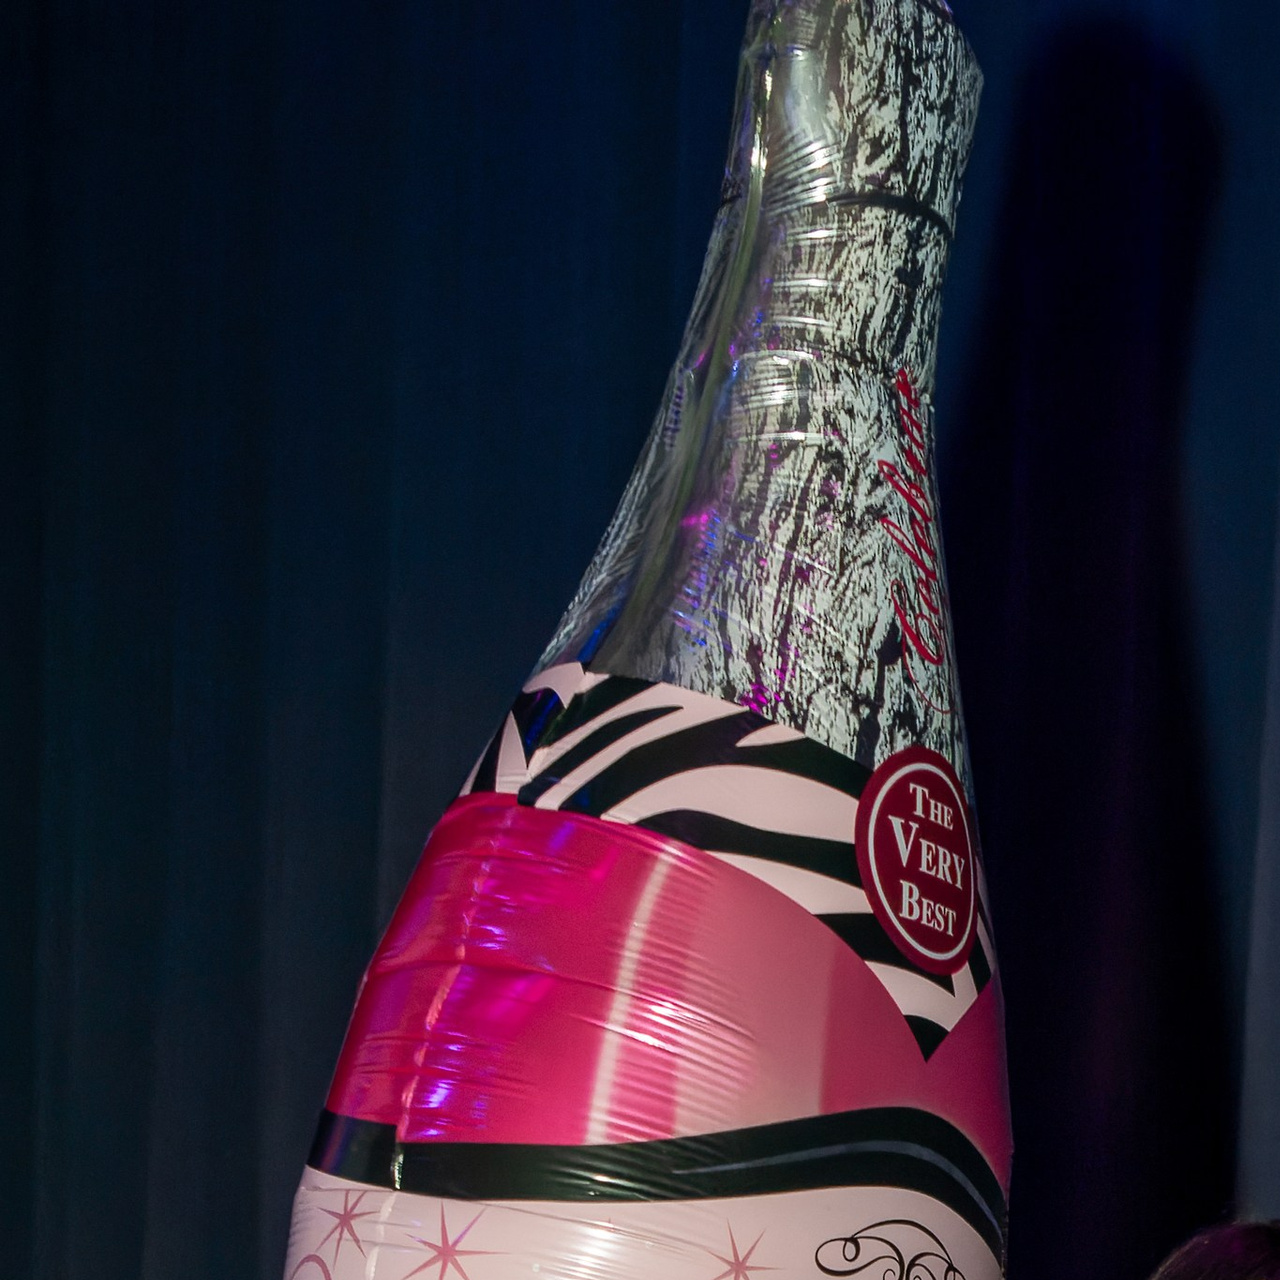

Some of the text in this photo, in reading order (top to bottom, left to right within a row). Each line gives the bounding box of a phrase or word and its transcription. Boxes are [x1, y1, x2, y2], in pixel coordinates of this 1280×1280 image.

[878, 366, 954, 714] Celebrat
[909, 782, 954, 830] THE
[888, 814, 966, 890] VERY
[899, 879, 957, 937] BEST
